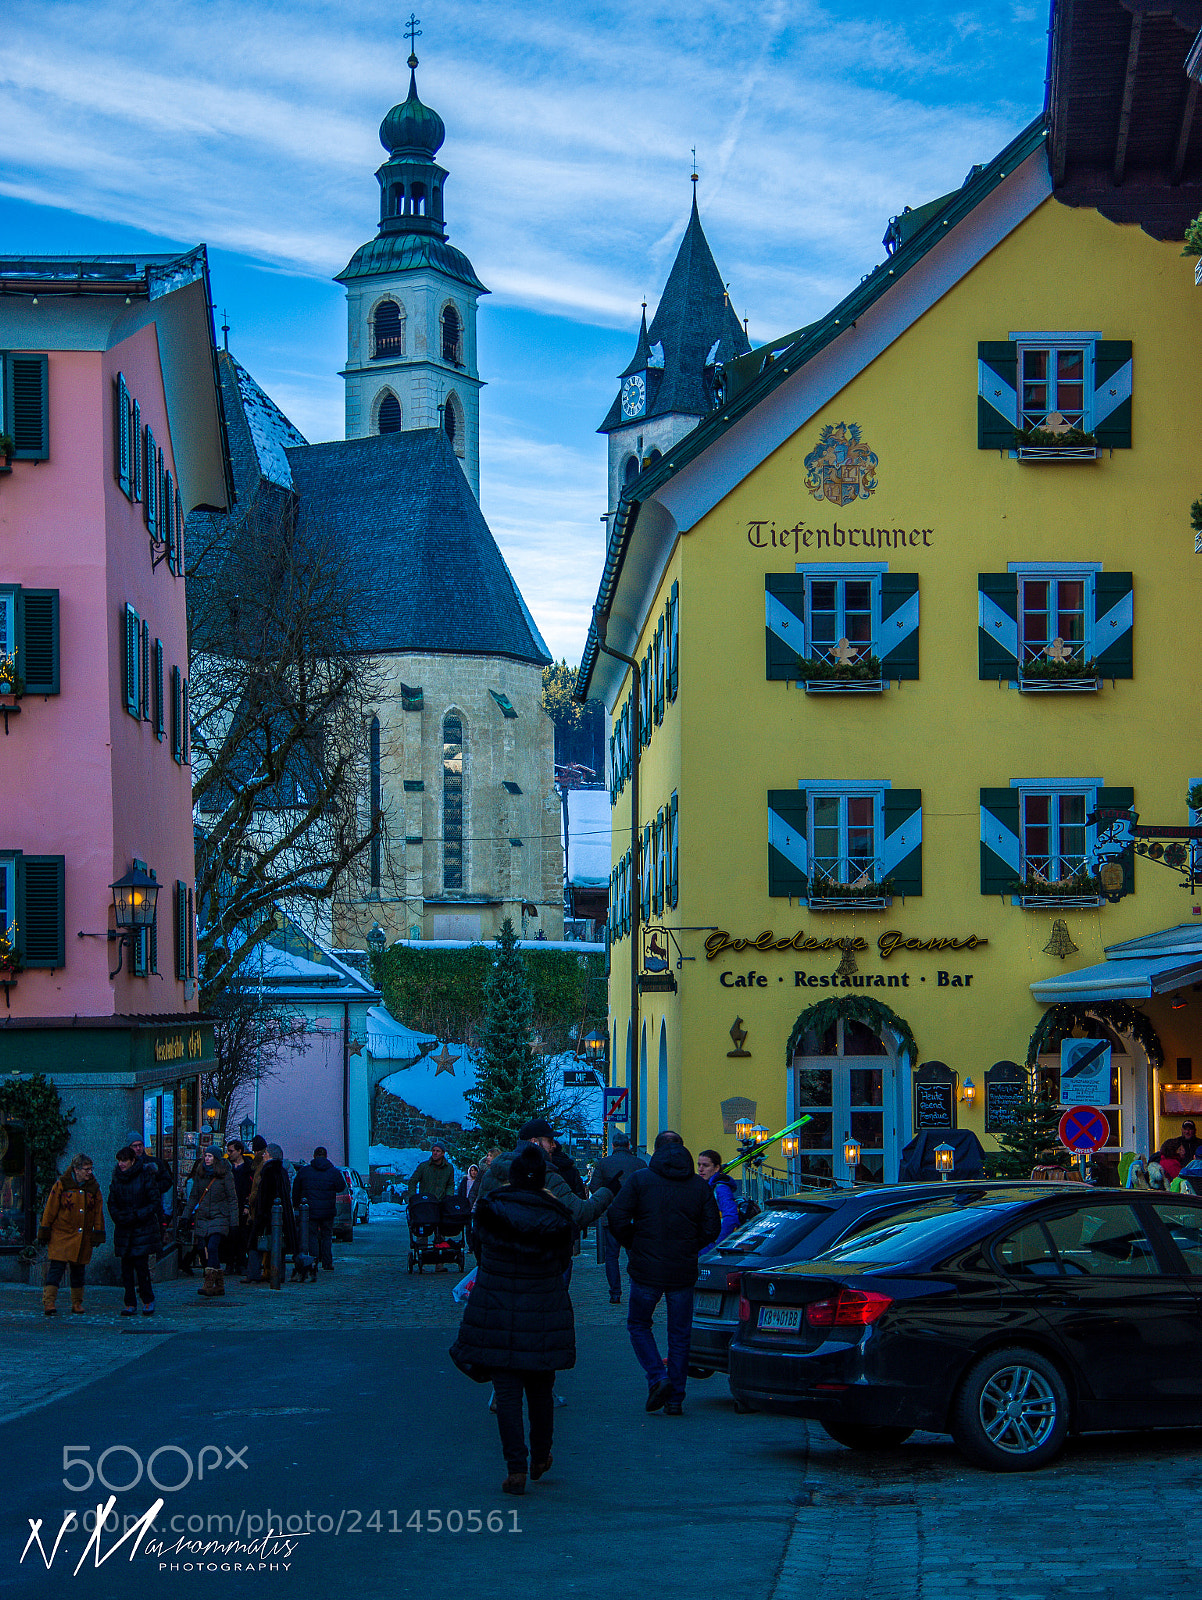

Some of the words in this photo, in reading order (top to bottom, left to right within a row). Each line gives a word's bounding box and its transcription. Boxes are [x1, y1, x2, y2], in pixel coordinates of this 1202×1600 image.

[746, 519, 935, 554] Tiefenbrunner
[1099, 809, 1132, 820] HOTEL
[1136, 827, 1202, 837] TIEFENBRUNN
[704, 929, 869, 961] Goldene
[877, 929, 989, 959] Gams
[720, 970, 768, 988] Cafe
[794, 970, 910, 988] Restaurant
[937, 970, 974, 988] Bar
